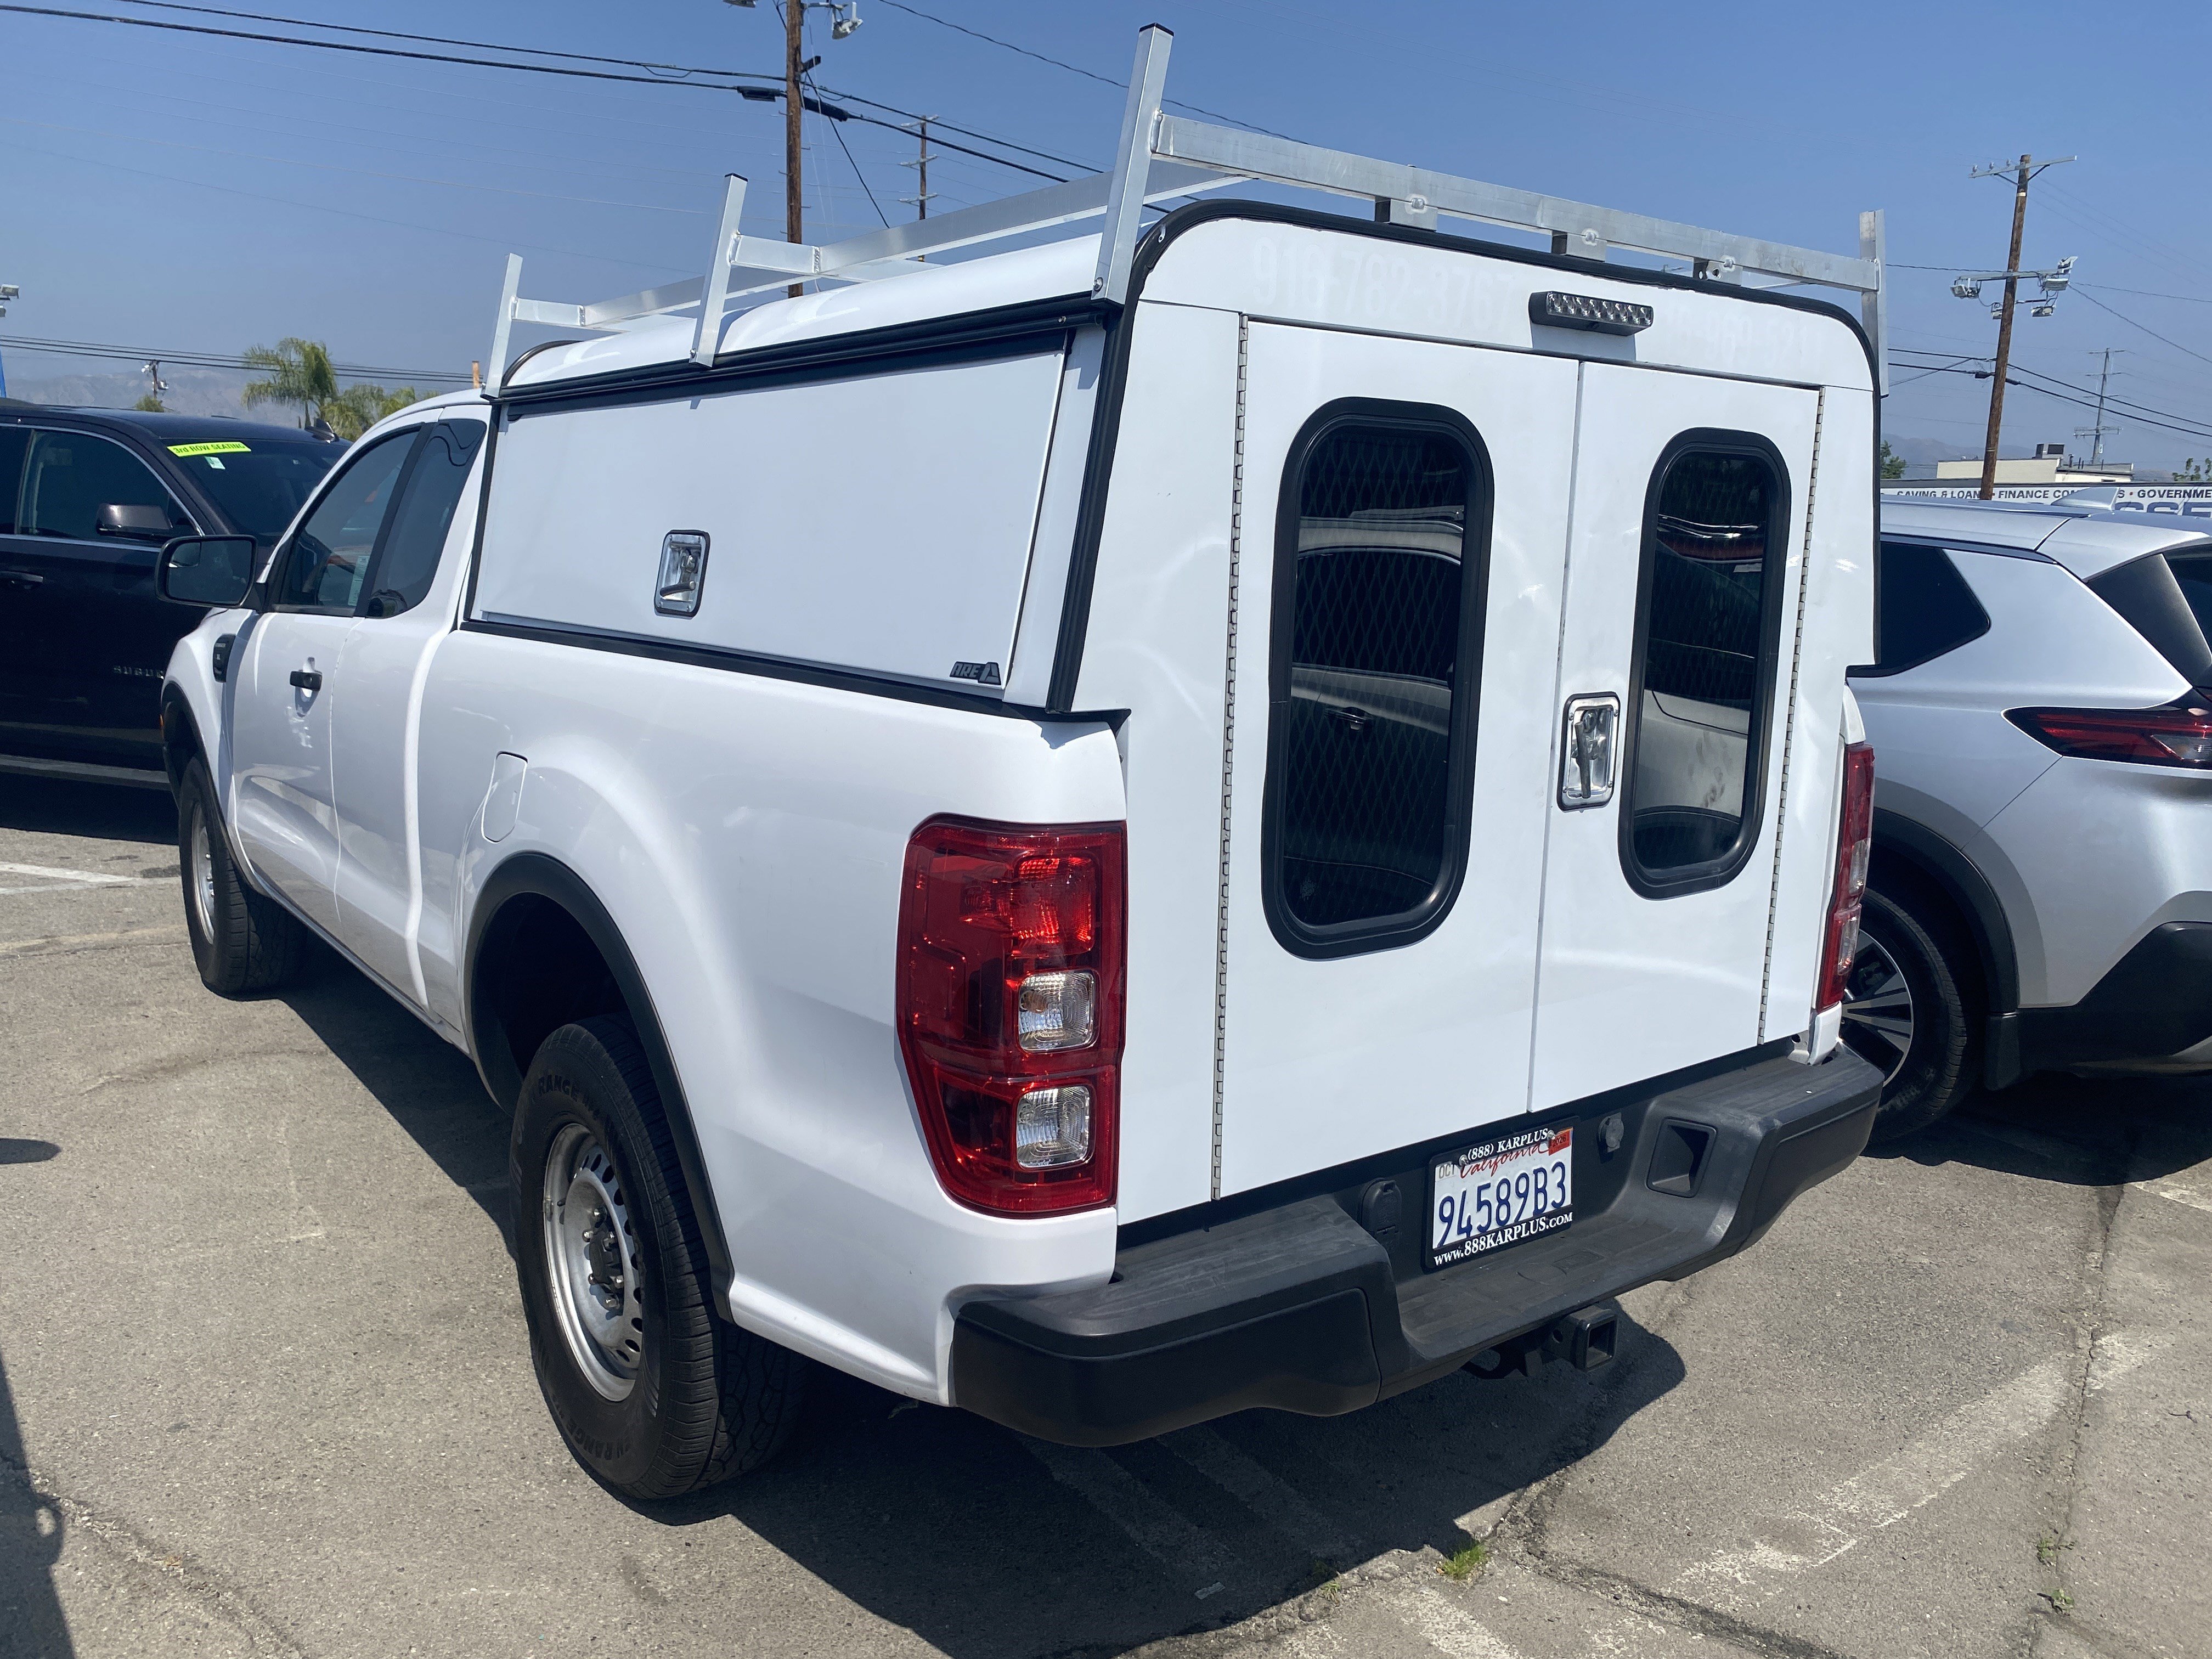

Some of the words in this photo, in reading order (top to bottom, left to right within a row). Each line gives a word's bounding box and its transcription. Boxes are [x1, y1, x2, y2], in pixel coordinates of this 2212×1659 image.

[1951, 490, 1980, 499] LOAN
[1998, 490, 2049, 499] FINANCE
[1459, 1142, 1549, 1179] California
[1468, 1143, 1494, 1160] (888)
[1497, 1128, 1548, 1153] KARPLUS
[1438, 1161, 1566, 1247] 94589B3
